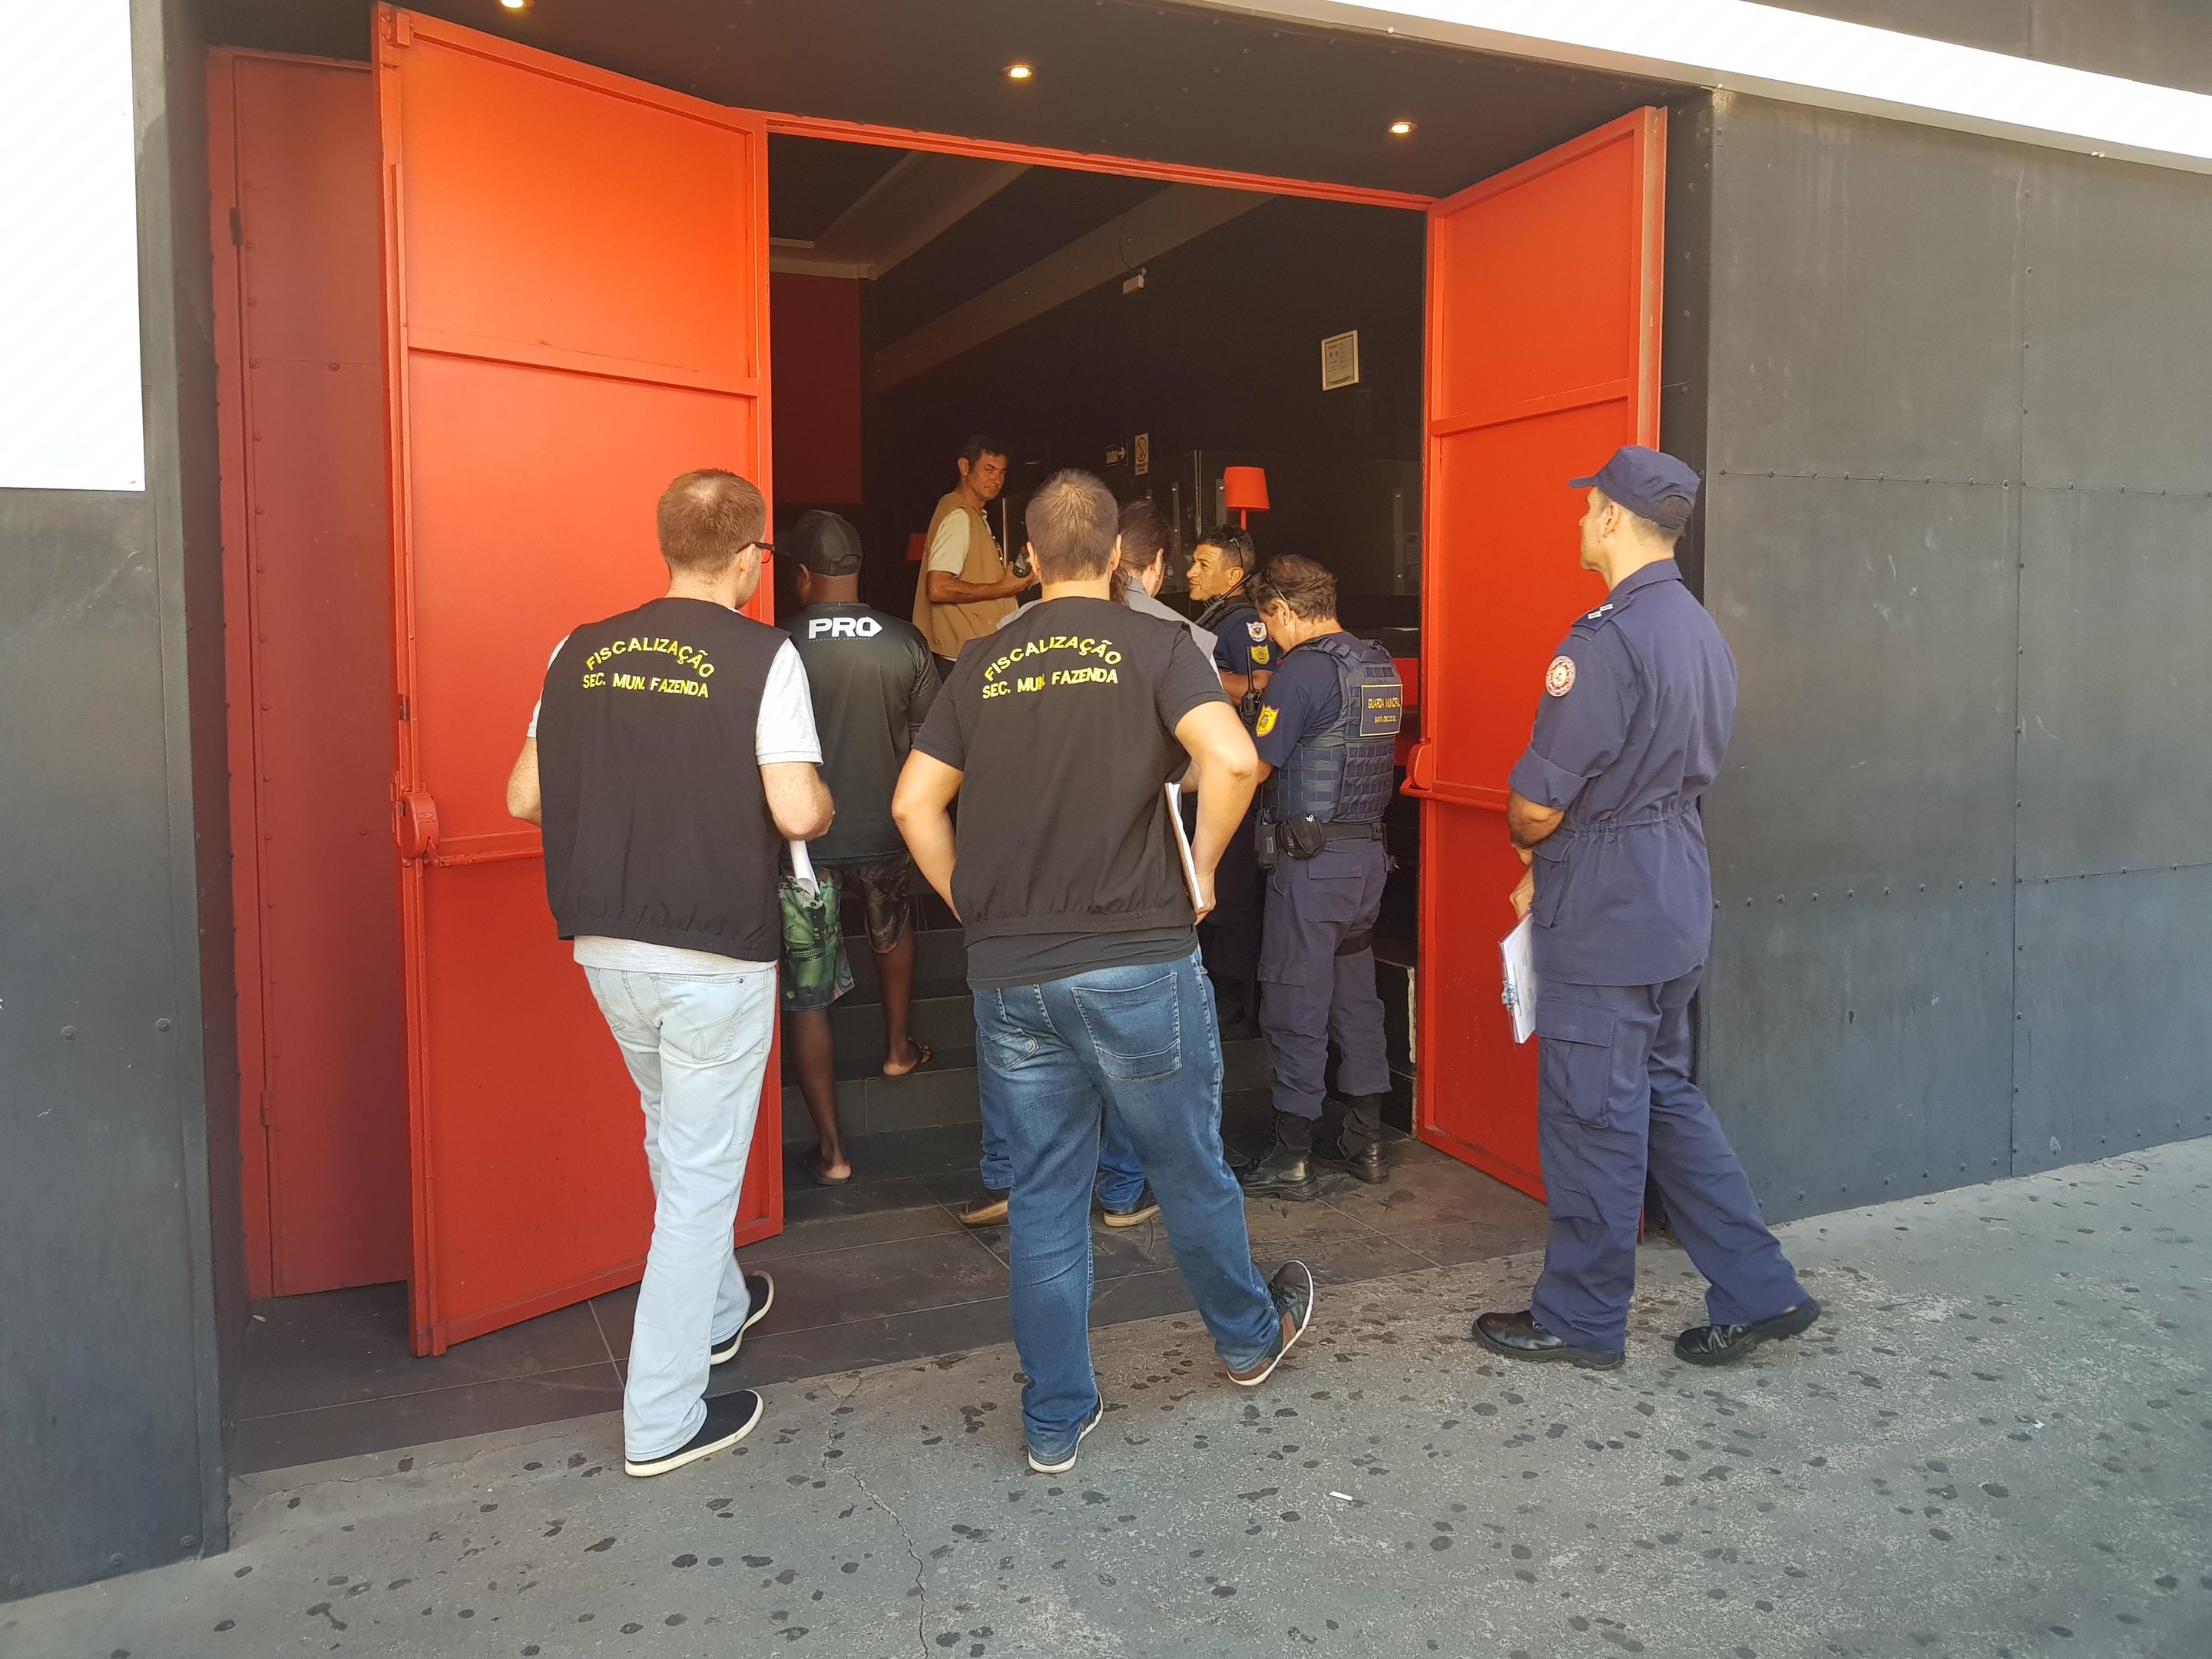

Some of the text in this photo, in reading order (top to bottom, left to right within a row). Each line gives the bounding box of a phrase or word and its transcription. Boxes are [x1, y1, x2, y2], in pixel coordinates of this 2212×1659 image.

[809, 616, 882, 639] PRO
[585, 637, 715, 678] FISCALIZAÇÃO
[984, 636, 1121, 682] FISCALIZAÇÃO
[583, 672, 709, 698] SEC. MUN. FAZENDA
[982, 680, 1011, 699] SEC.
[1051, 667, 1118, 685] FAZENDA
